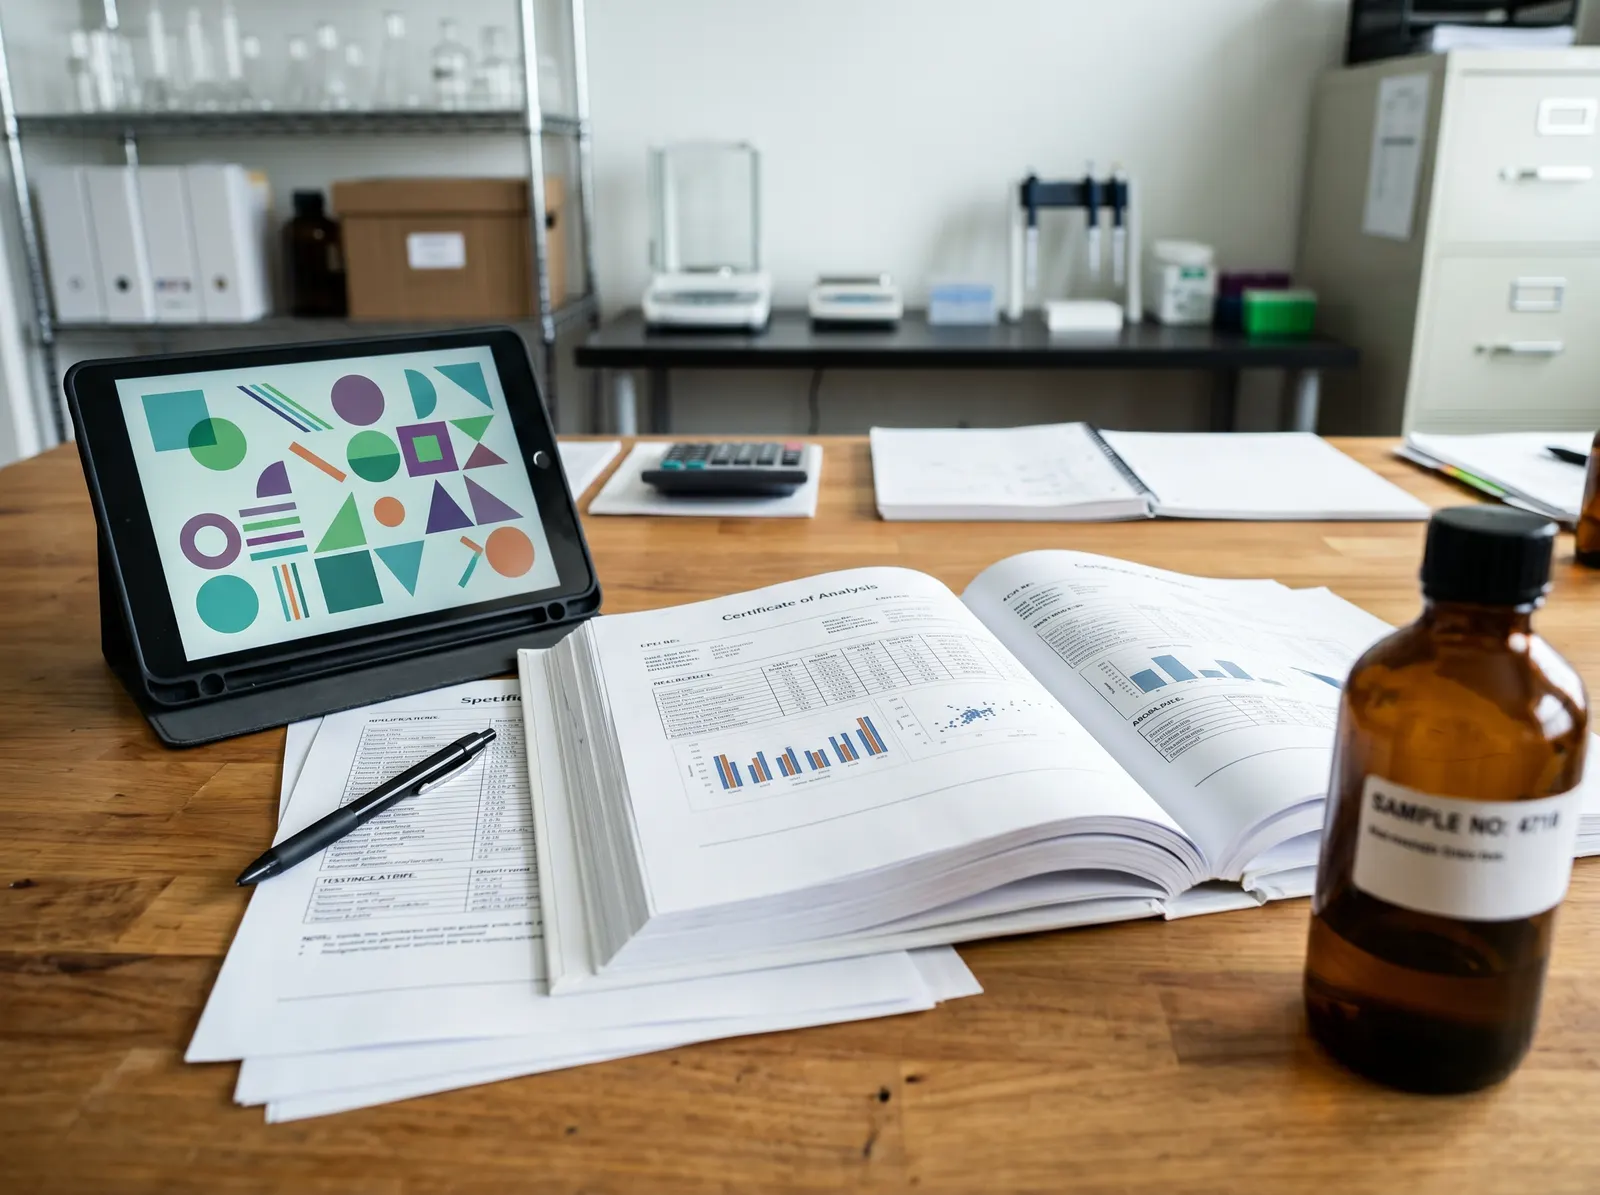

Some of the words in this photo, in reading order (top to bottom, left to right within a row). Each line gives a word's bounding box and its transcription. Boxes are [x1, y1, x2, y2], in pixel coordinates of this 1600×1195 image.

[722, 600, 796, 621] Certificate
[818, 584, 879, 600] Analysis
[1371, 792, 1461, 834] SAMPLE
